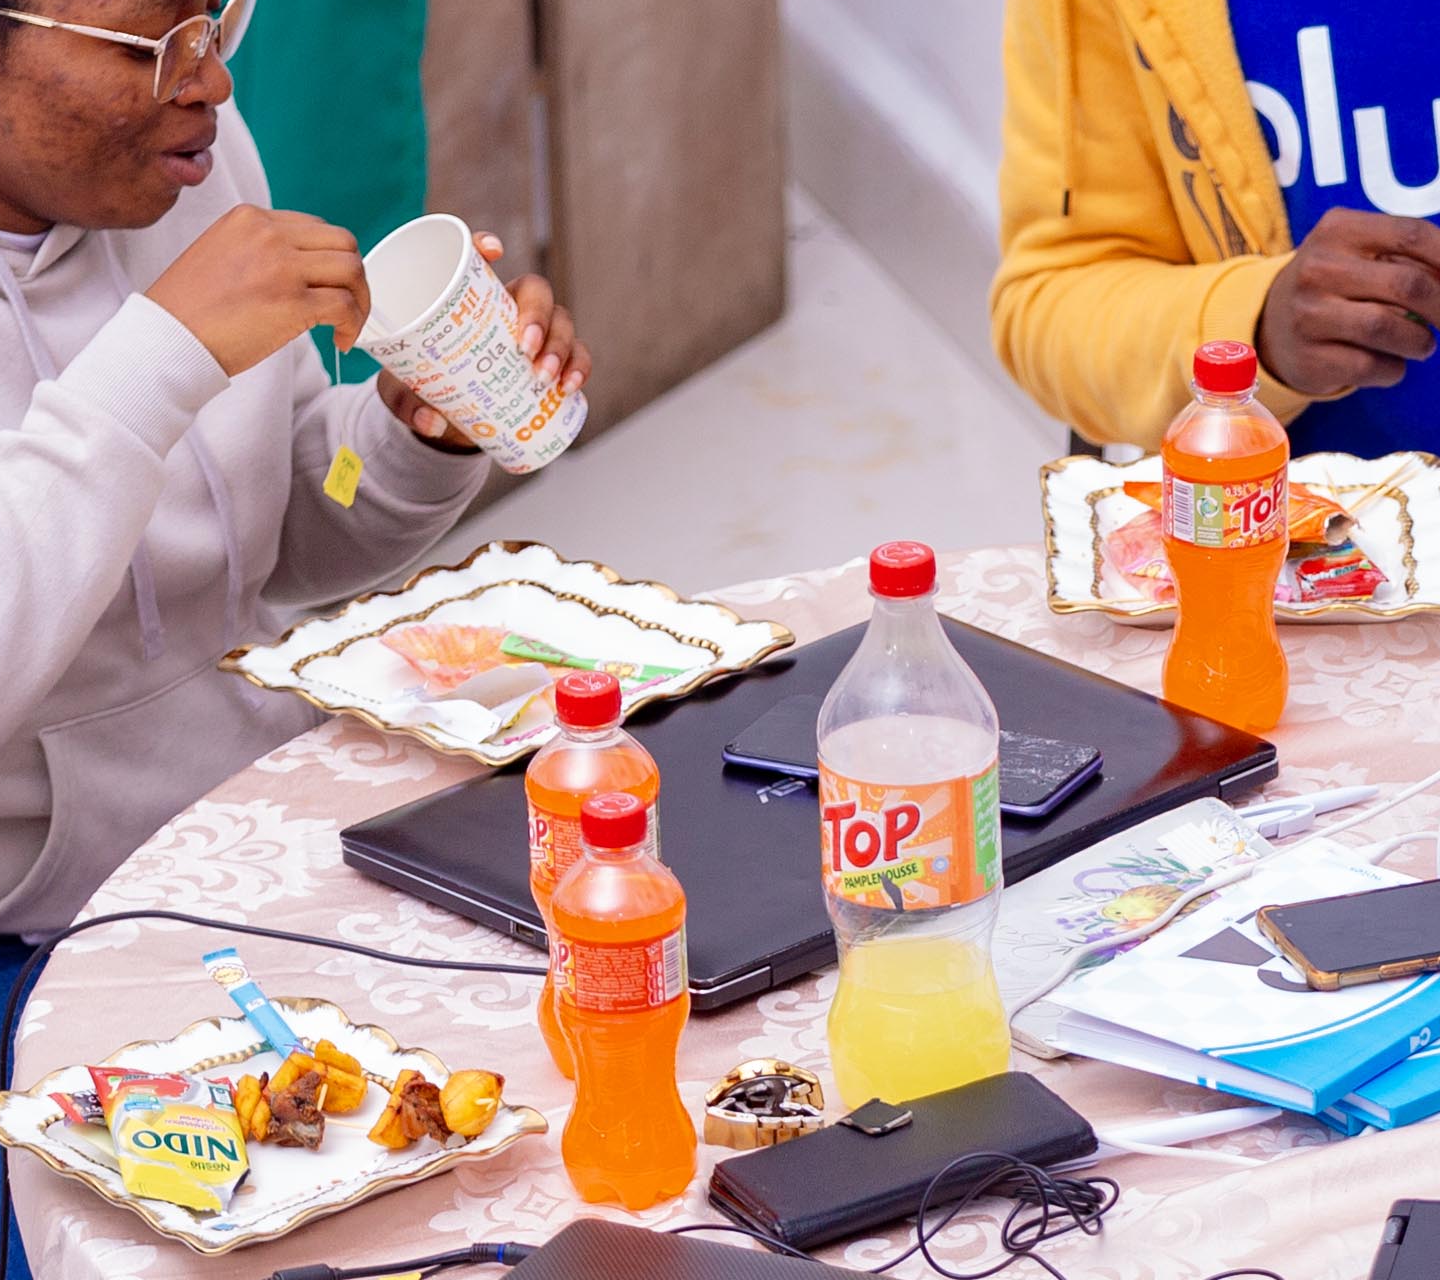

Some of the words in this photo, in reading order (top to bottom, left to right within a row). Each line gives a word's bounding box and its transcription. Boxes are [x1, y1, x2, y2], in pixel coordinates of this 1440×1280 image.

[422, 324, 453, 349] Ciao
[476, 342, 507, 373] Ola
[131, 1129, 240, 1162] NIDO
